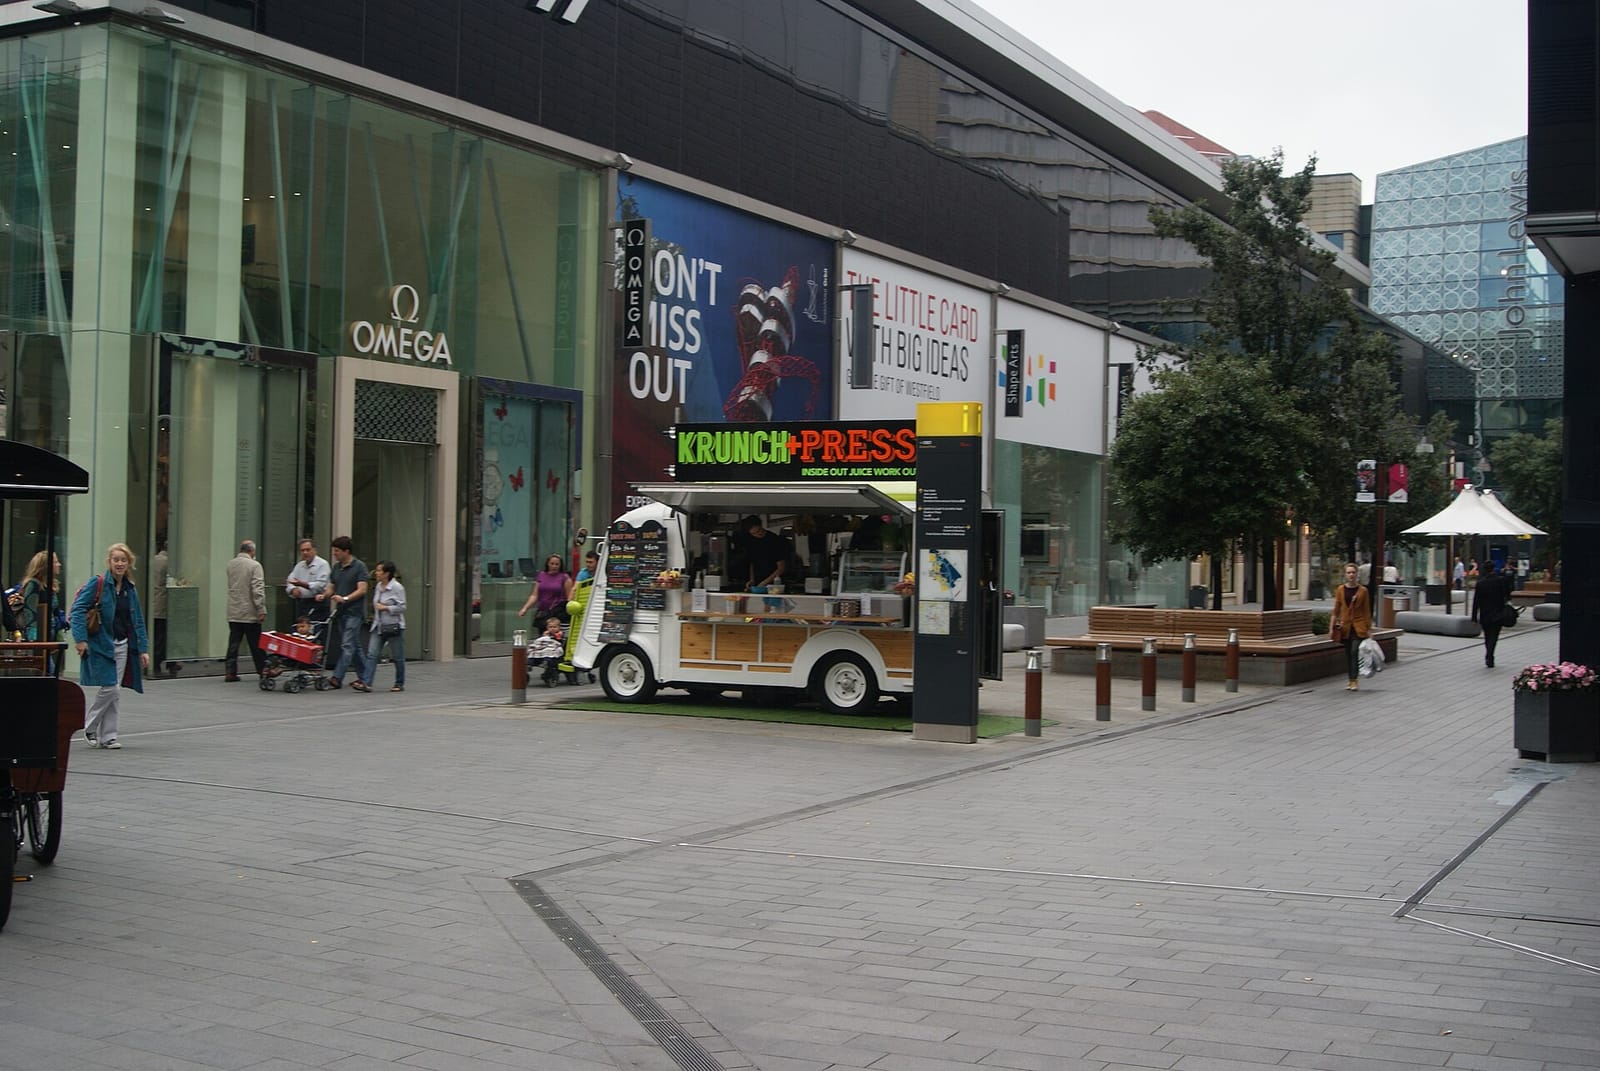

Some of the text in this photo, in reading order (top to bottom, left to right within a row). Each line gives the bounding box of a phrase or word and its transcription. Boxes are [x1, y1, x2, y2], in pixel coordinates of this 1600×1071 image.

[649, 249, 722, 306] ON'T
[1497, 169, 1535, 339] John Lewis
[626, 256, 643, 340] OMEGA
[885, 281, 936, 332] LITTLE
[939, 298, 979, 342] CARD
[351, 320, 453, 365] OMEGA
[897, 329, 921, 372] BIG
[926, 337, 969, 383] IDEAS
[628, 351, 693, 404] OUT
[1007, 344, 1020, 404] Shape Arts
[801, 467, 917, 476] INSIDE OUT JUICE WORK OU
